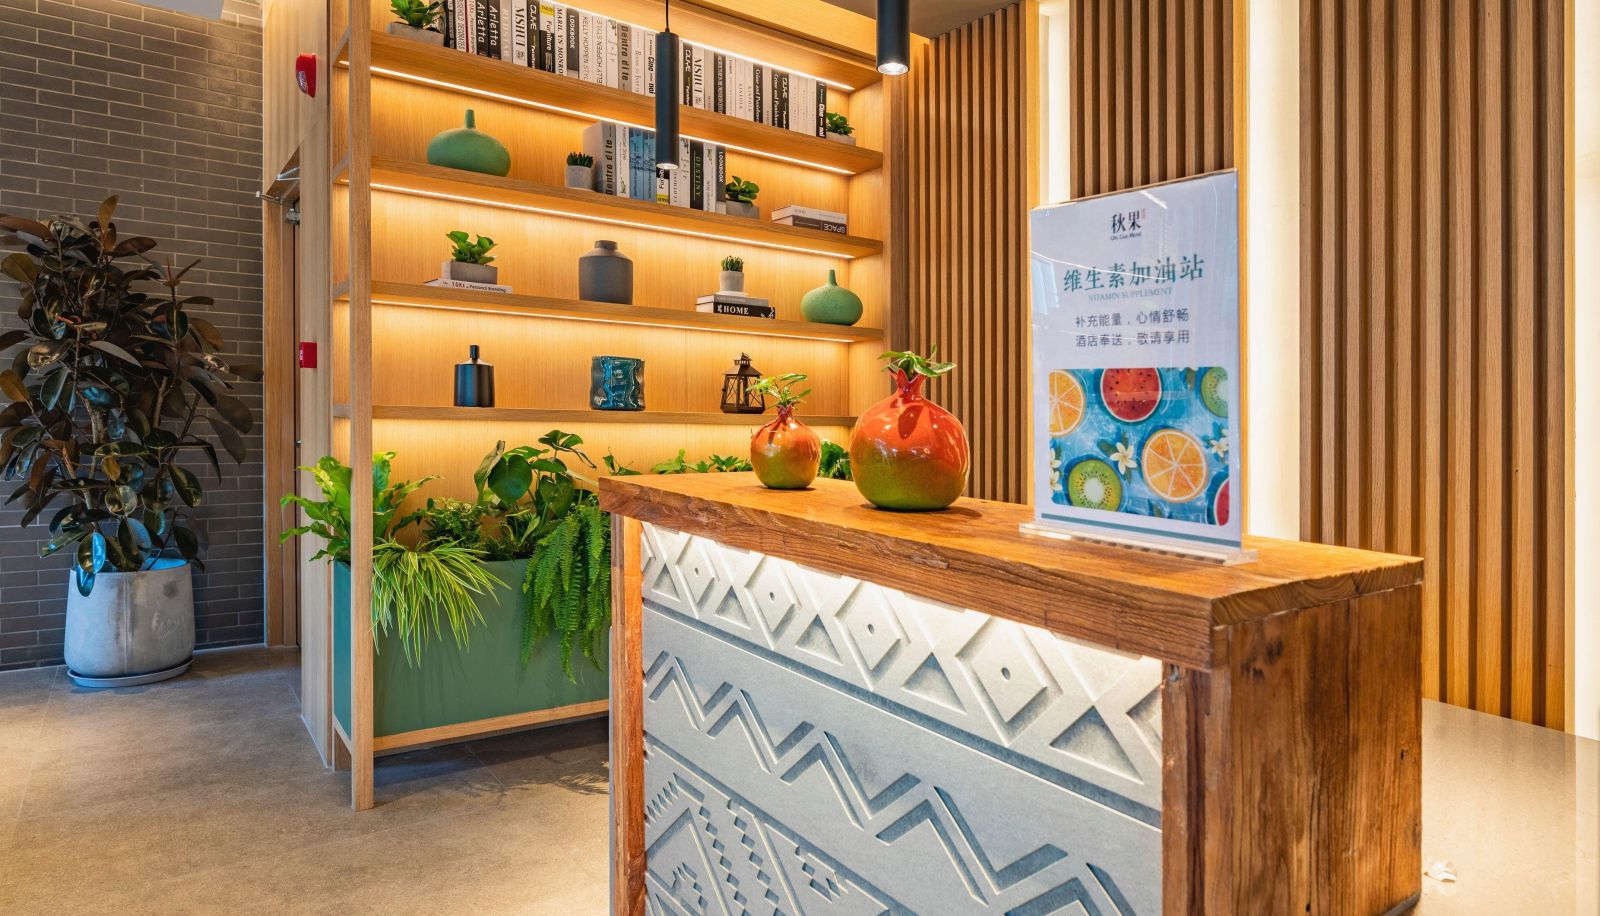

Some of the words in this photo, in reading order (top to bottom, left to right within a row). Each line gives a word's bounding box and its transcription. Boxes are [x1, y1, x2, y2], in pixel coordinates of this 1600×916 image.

[477, 2, 487, 43] Arletta
[490, 5, 499, 46] Arletta
[621, 25, 629, 57] Dentro
[621, 60, 629, 70] di
[622, 71, 629, 81] te
[605, 164, 613, 195] Dentro
[823, 223, 846, 234] SPACE
[1111, 210, 1141, 234] 秋果
[1063, 253, 1204, 293] 维生素加油站
[1088, 292, 1120, 301] VITAMIN
[1121, 287, 1173, 298] SUPPLEMENT
[723, 305, 749, 315] HOME
